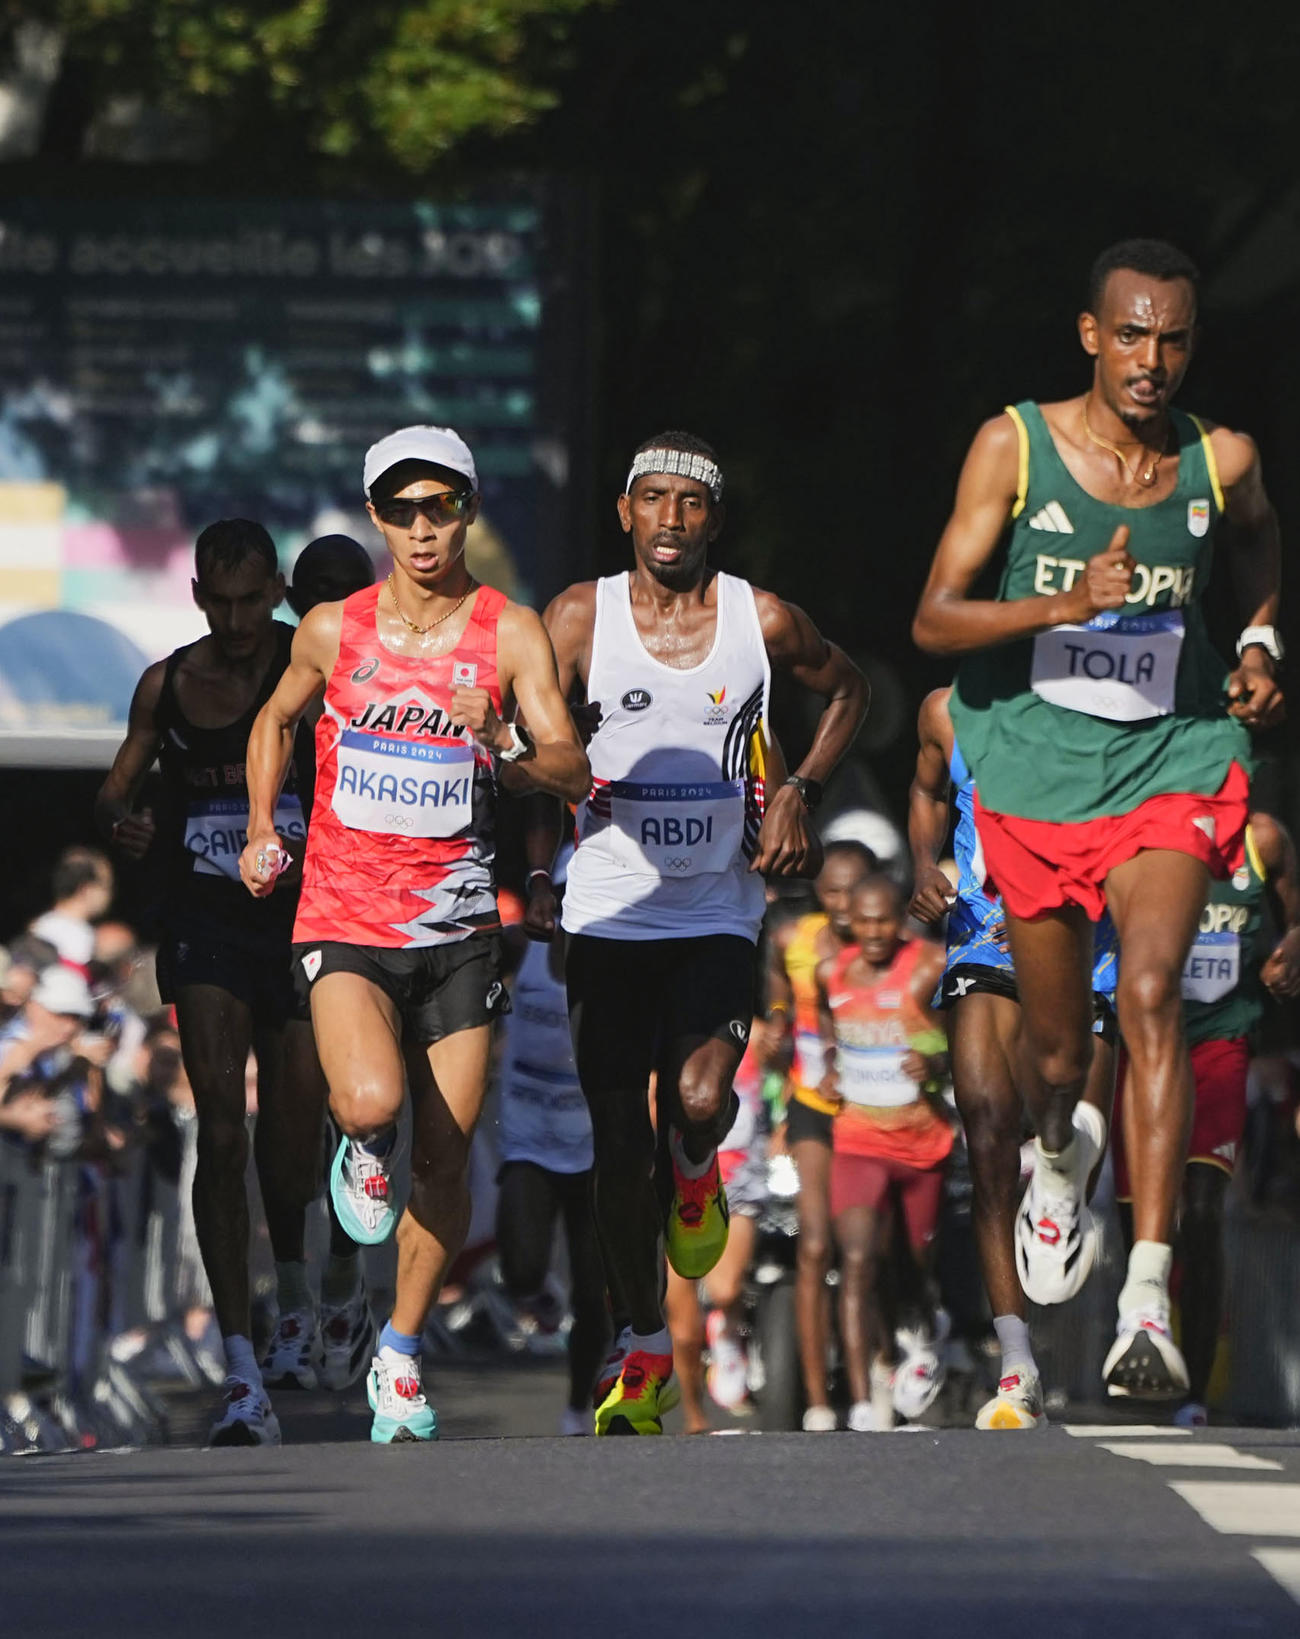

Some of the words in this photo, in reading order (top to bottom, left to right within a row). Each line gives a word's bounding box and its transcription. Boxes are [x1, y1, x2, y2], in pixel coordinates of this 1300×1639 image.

[1034, 553, 1195, 608] ETOPIA
[1064, 643, 1154, 685] TOLA
[372, 740, 407, 756] PARIS
[411, 745, 443, 761] 2024
[339, 764, 470, 808] AKASAKI
[641, 787, 677, 798] PARIS
[680, 787, 713, 798] 2024
[188, 820, 305, 857] CAIS
[641, 815, 713, 847] ABDI
[1184, 957, 1232, 980] ETA
